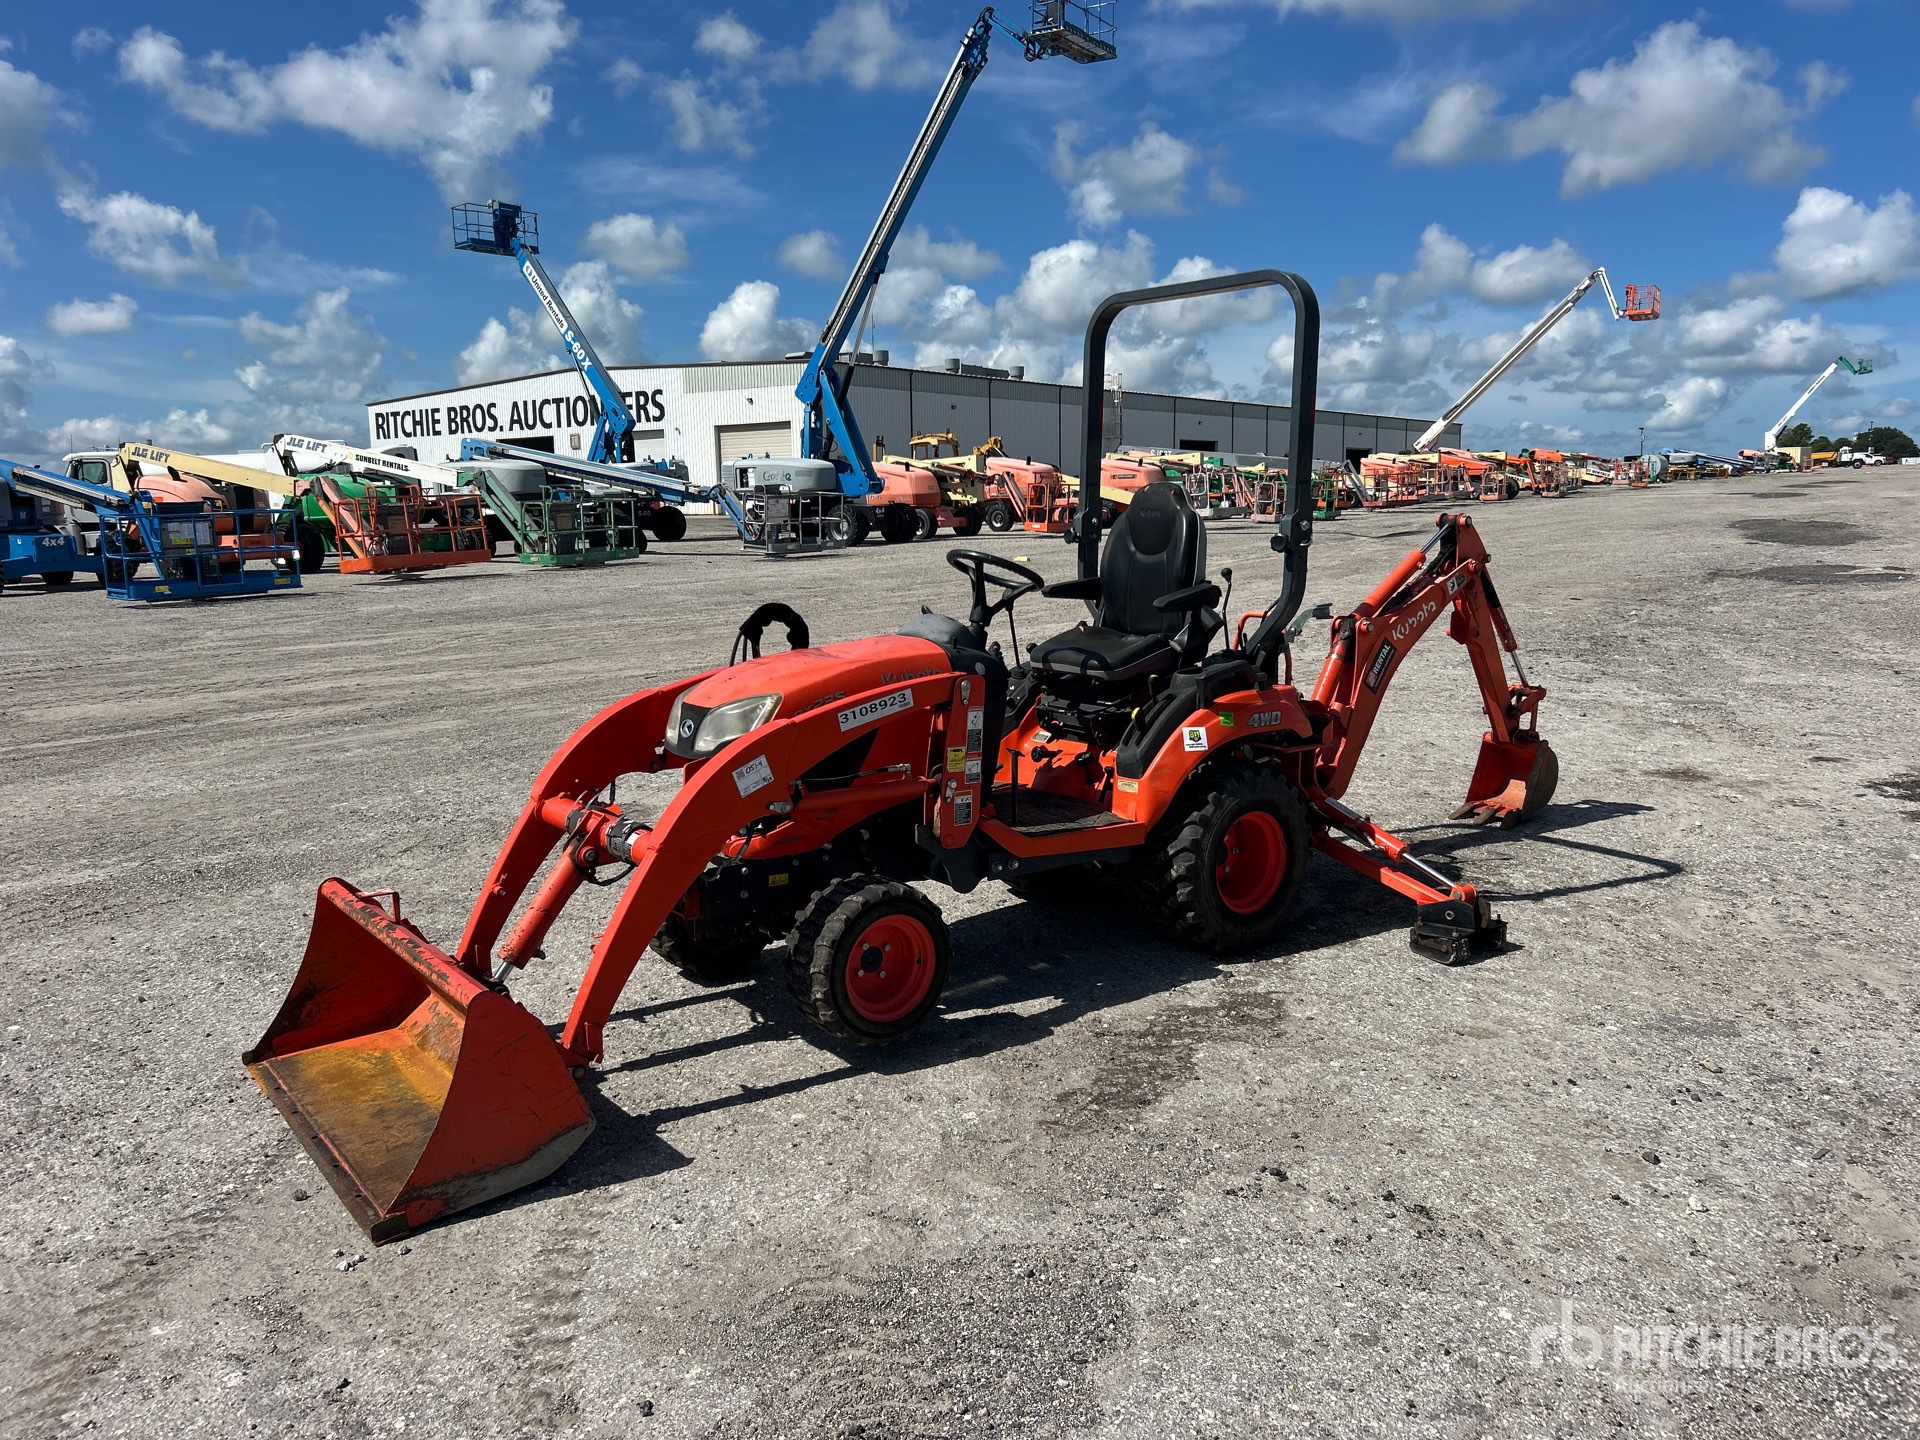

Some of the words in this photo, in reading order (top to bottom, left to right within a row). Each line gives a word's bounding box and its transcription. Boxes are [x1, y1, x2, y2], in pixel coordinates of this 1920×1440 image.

[532, 275, 548, 302] United
[546, 299, 565, 329] Rentals
[375, 407, 442, 440] RITCHIE
[447, 402, 504, 435] BROS.
[509, 389, 666, 432] AUCTIONERS
[286, 437, 305, 449] JLG
[306, 440, 327, 453] LIFT
[131, 447, 149, 460] JLG
[150, 451, 171, 464] LIFT
[355, 453, 381, 466] SUNBELT
[763, 470, 792, 482] Geie
[42, 536, 65, 547] 4x4
[1392, 601, 1437, 640] Kubota
[1372, 644, 1391, 675] RENTAL
[840, 692, 907, 724] 3108923
[1248, 711, 1281, 728] 4WD
